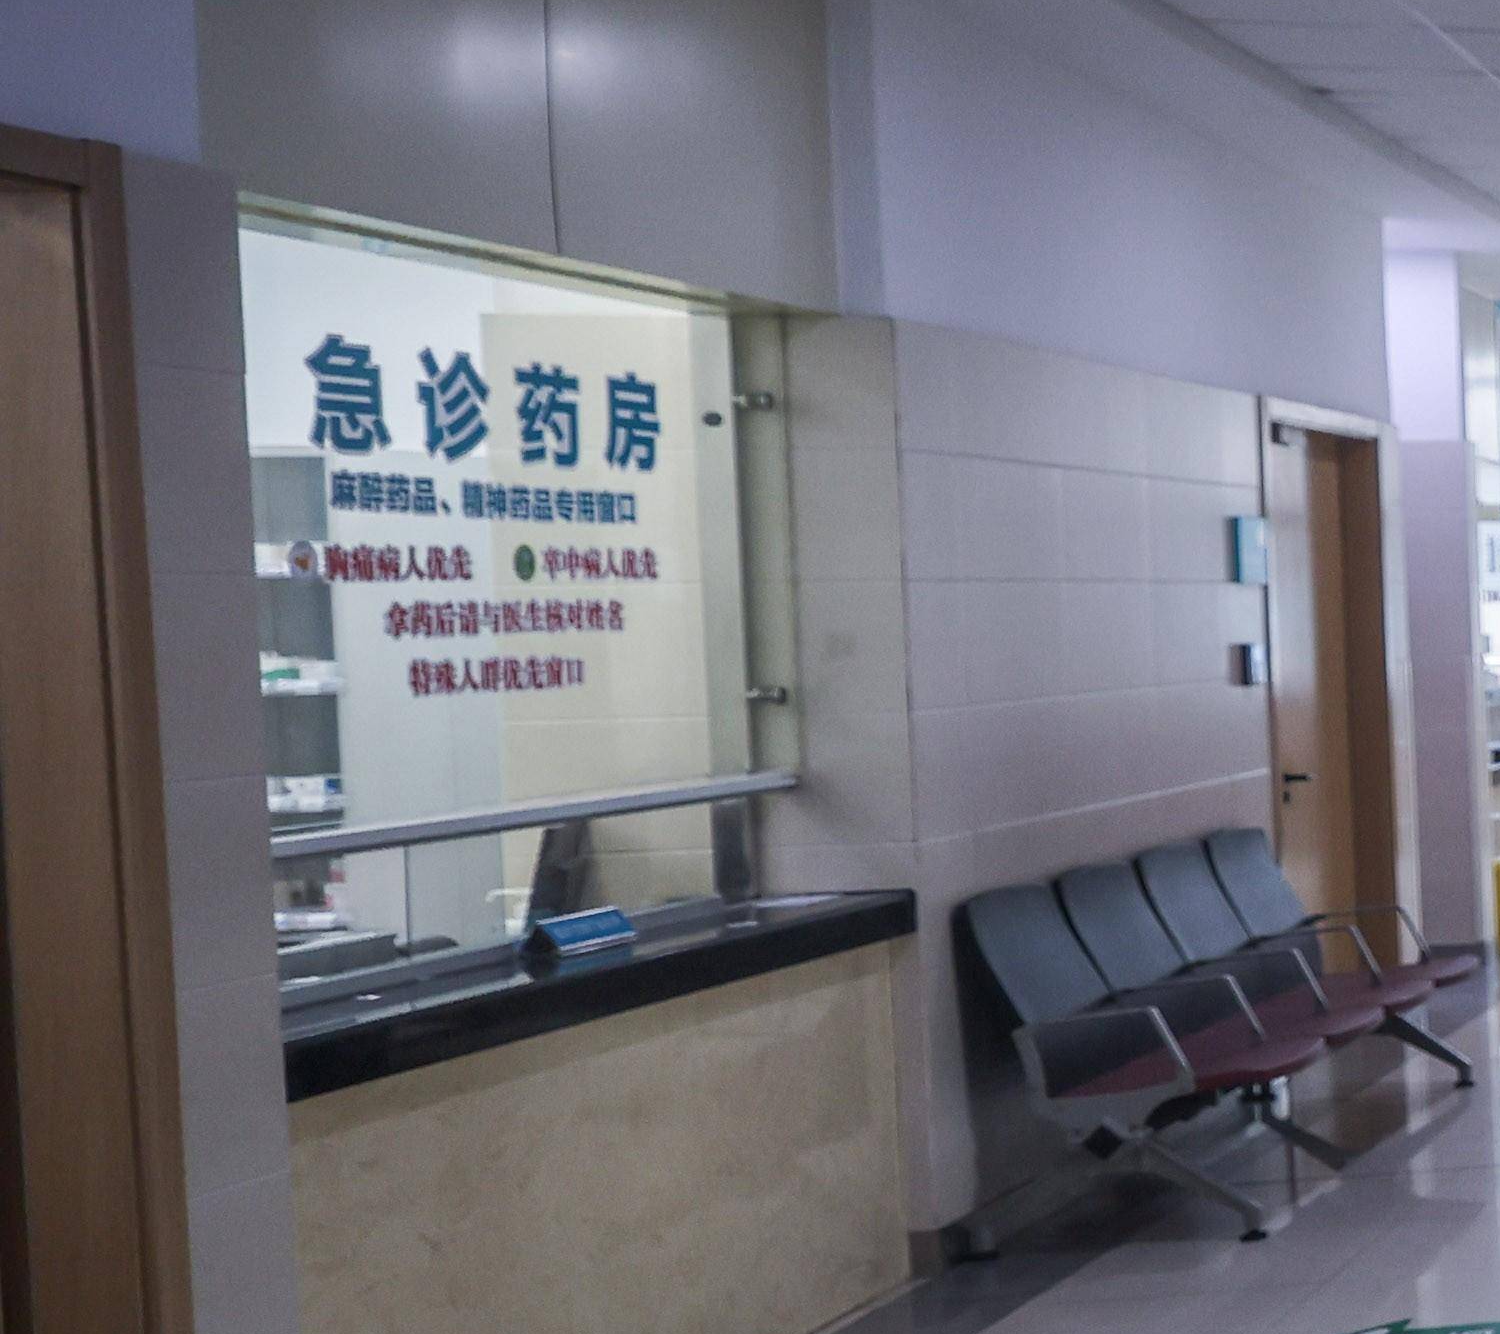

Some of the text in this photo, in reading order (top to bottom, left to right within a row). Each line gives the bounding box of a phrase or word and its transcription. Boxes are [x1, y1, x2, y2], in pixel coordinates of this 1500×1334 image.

[305, 333, 660, 470] 急诊药房
[324, 543, 472, 582] 胸痛病人优先
